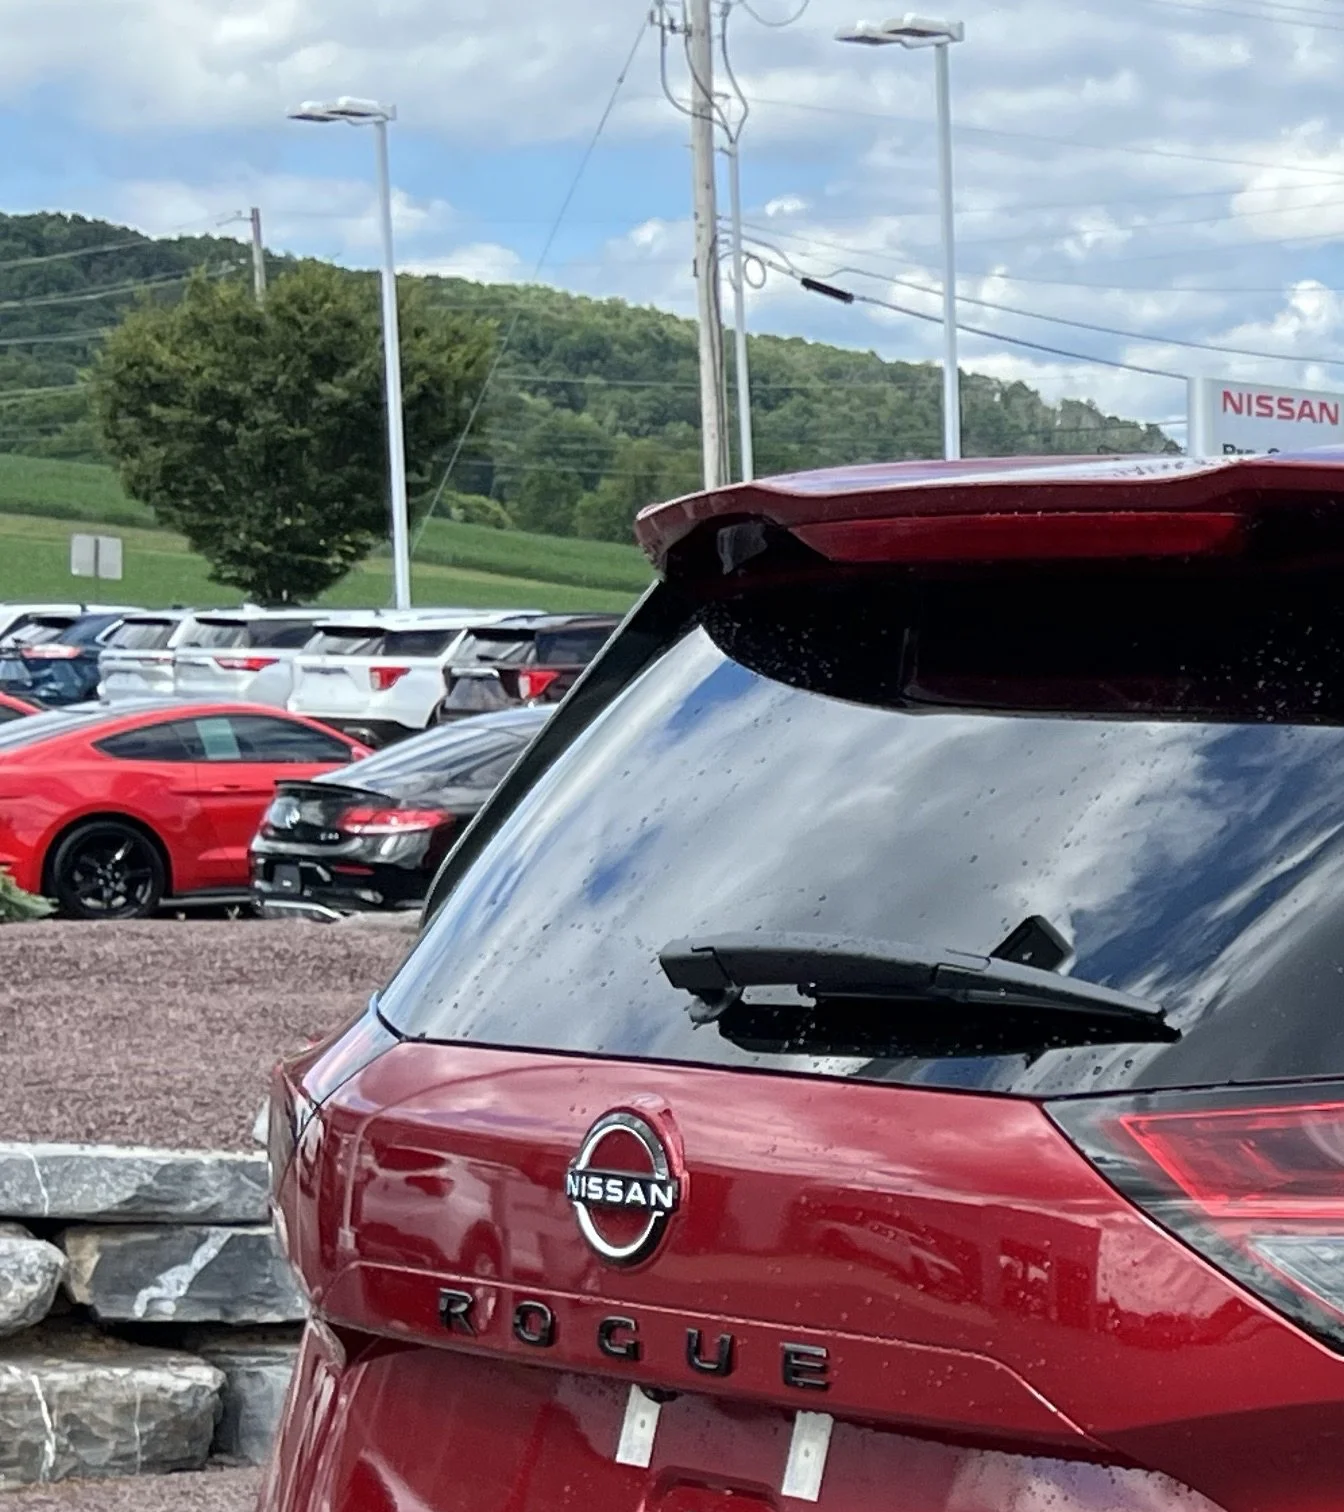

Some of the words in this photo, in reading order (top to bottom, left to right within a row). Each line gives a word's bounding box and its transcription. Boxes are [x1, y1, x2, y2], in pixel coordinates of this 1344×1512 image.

[1222, 390, 1339, 426] NISSAN
[566, 1174, 673, 1209] NISSAN
[439, 1287, 831, 1391] ROGUE
